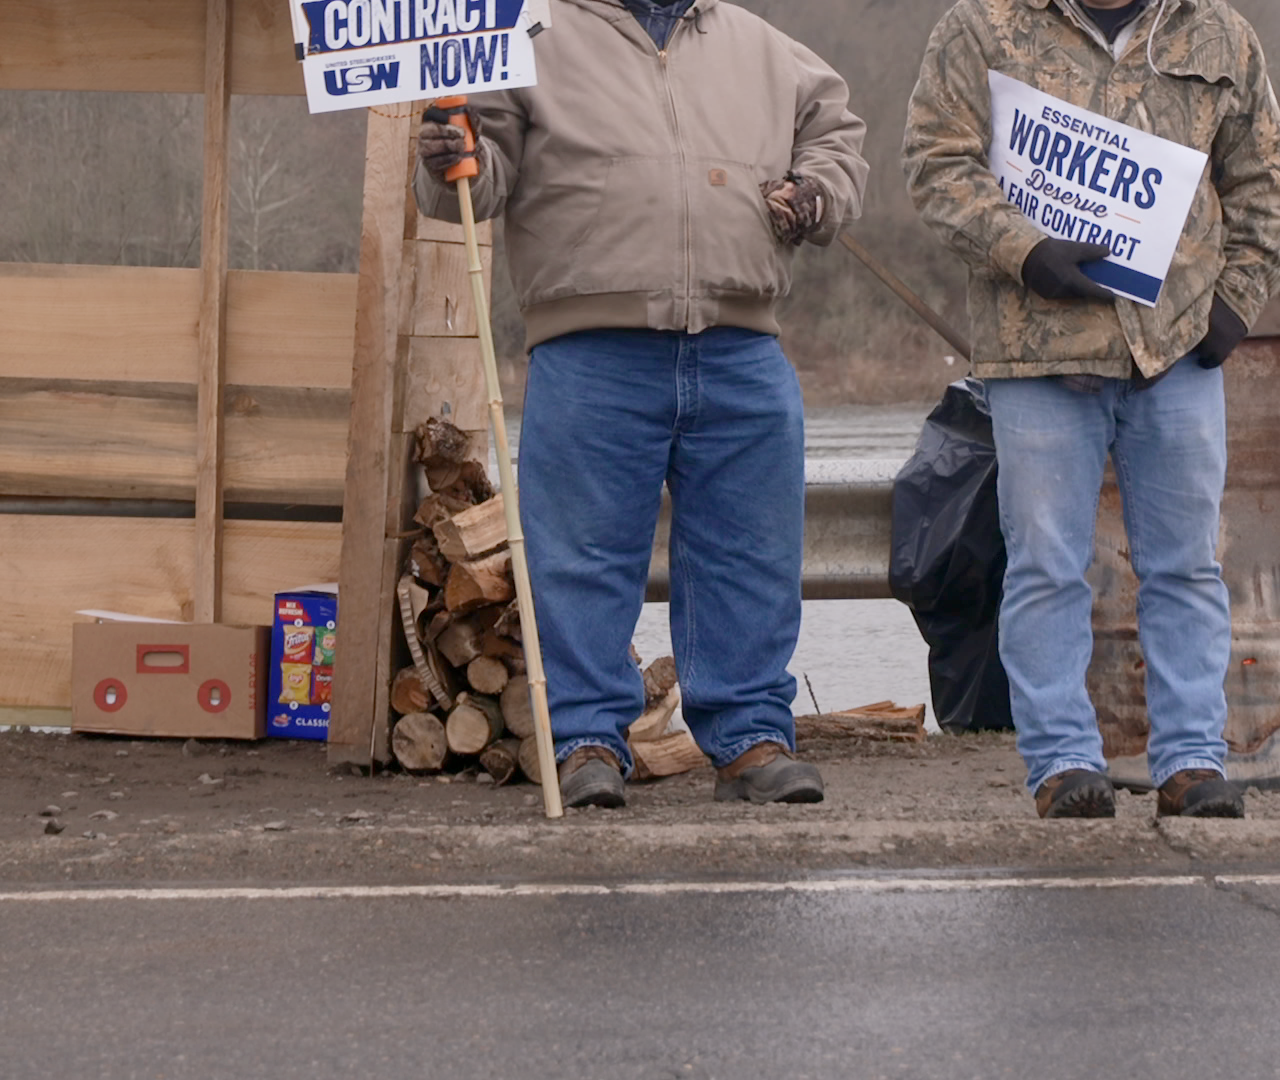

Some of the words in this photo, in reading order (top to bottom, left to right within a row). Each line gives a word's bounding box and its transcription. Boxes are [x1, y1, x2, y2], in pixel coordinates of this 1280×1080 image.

[323, 60, 401, 97] USW
[420, 32, 510, 92] NOW!
[1041, 106, 1131, 153] ESSENTIAL
[1009, 107, 1163, 210] WORKERS
[1025, 168, 1109, 219] Deserve
[1007, 183, 1039, 221] FAIR
[1041, 202, 1142, 262] CONTRACT
